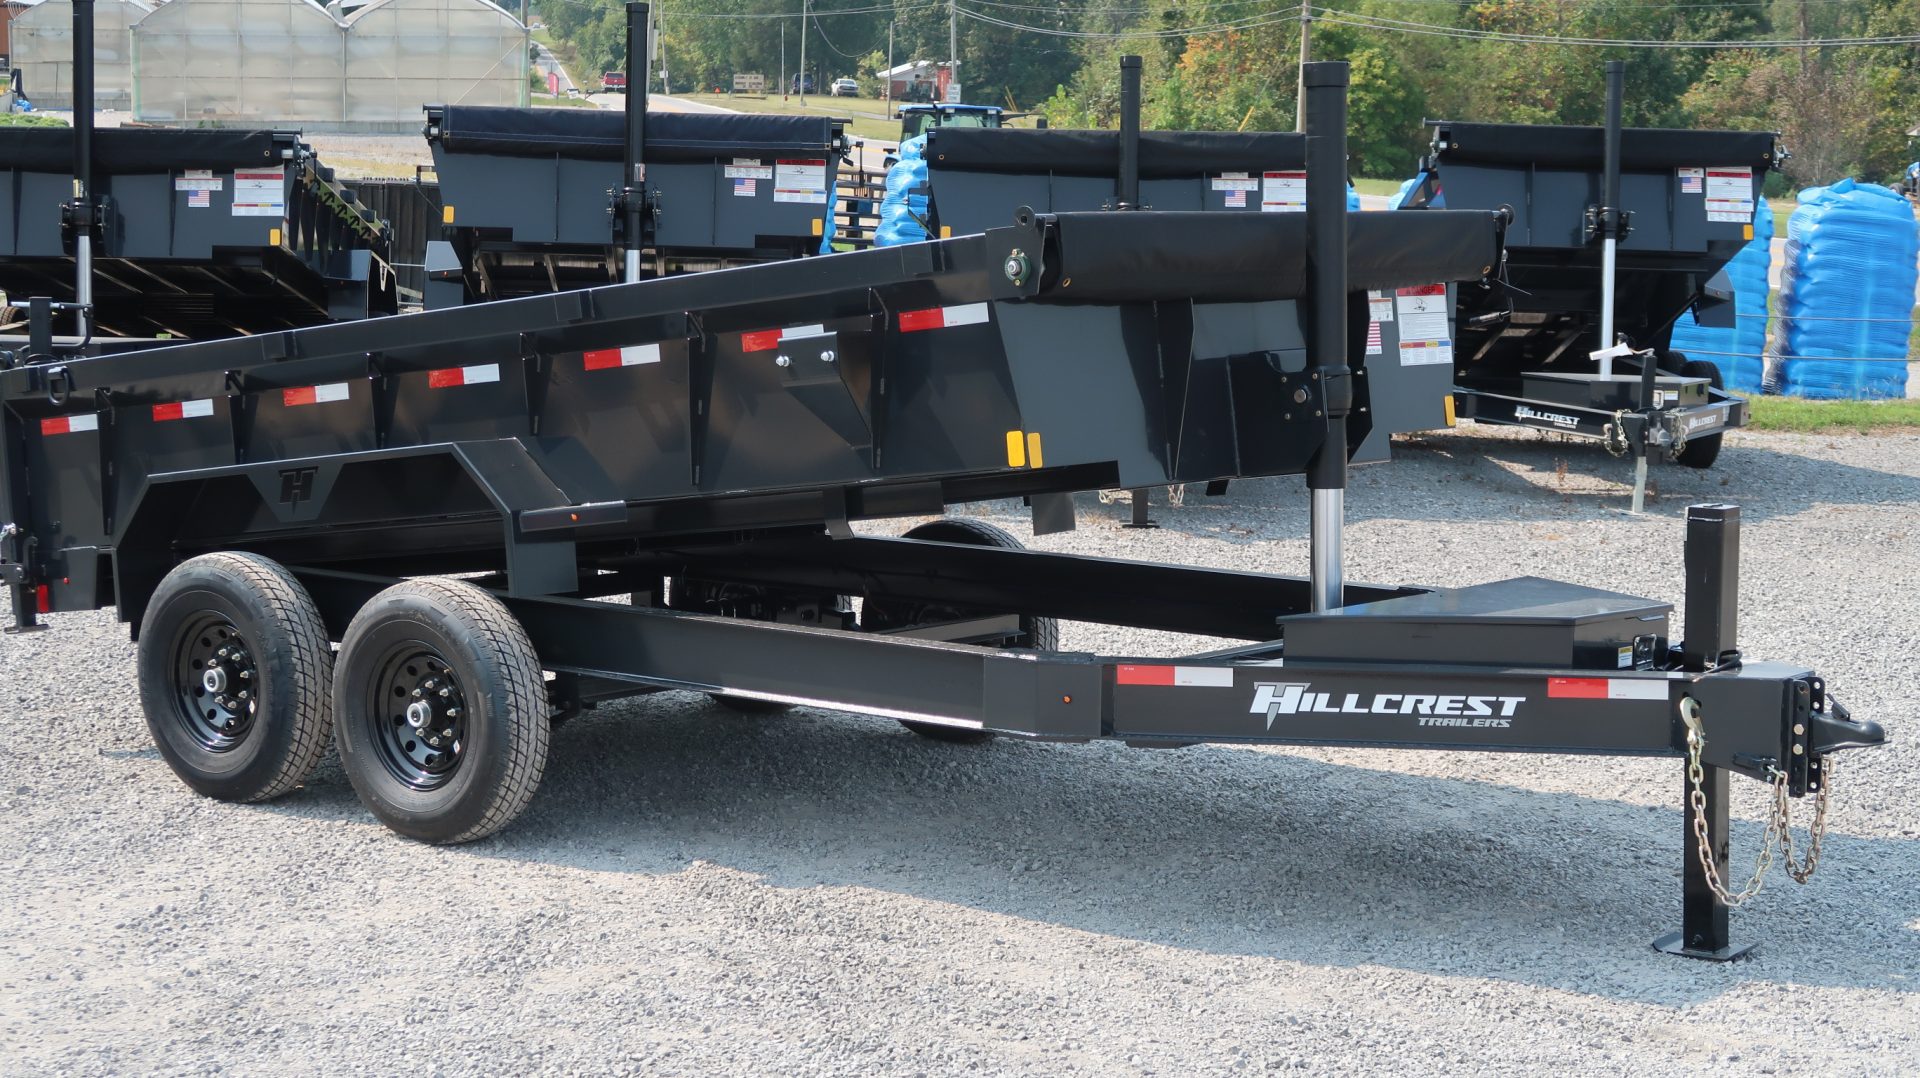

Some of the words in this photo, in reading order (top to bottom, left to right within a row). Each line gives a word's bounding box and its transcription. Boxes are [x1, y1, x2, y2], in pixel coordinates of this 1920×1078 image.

[1514, 404, 1581, 425] HILLCREST
[1249, 681, 1527, 727] HILLCREST
[1417, 717, 1512, 728] TRAILERS
